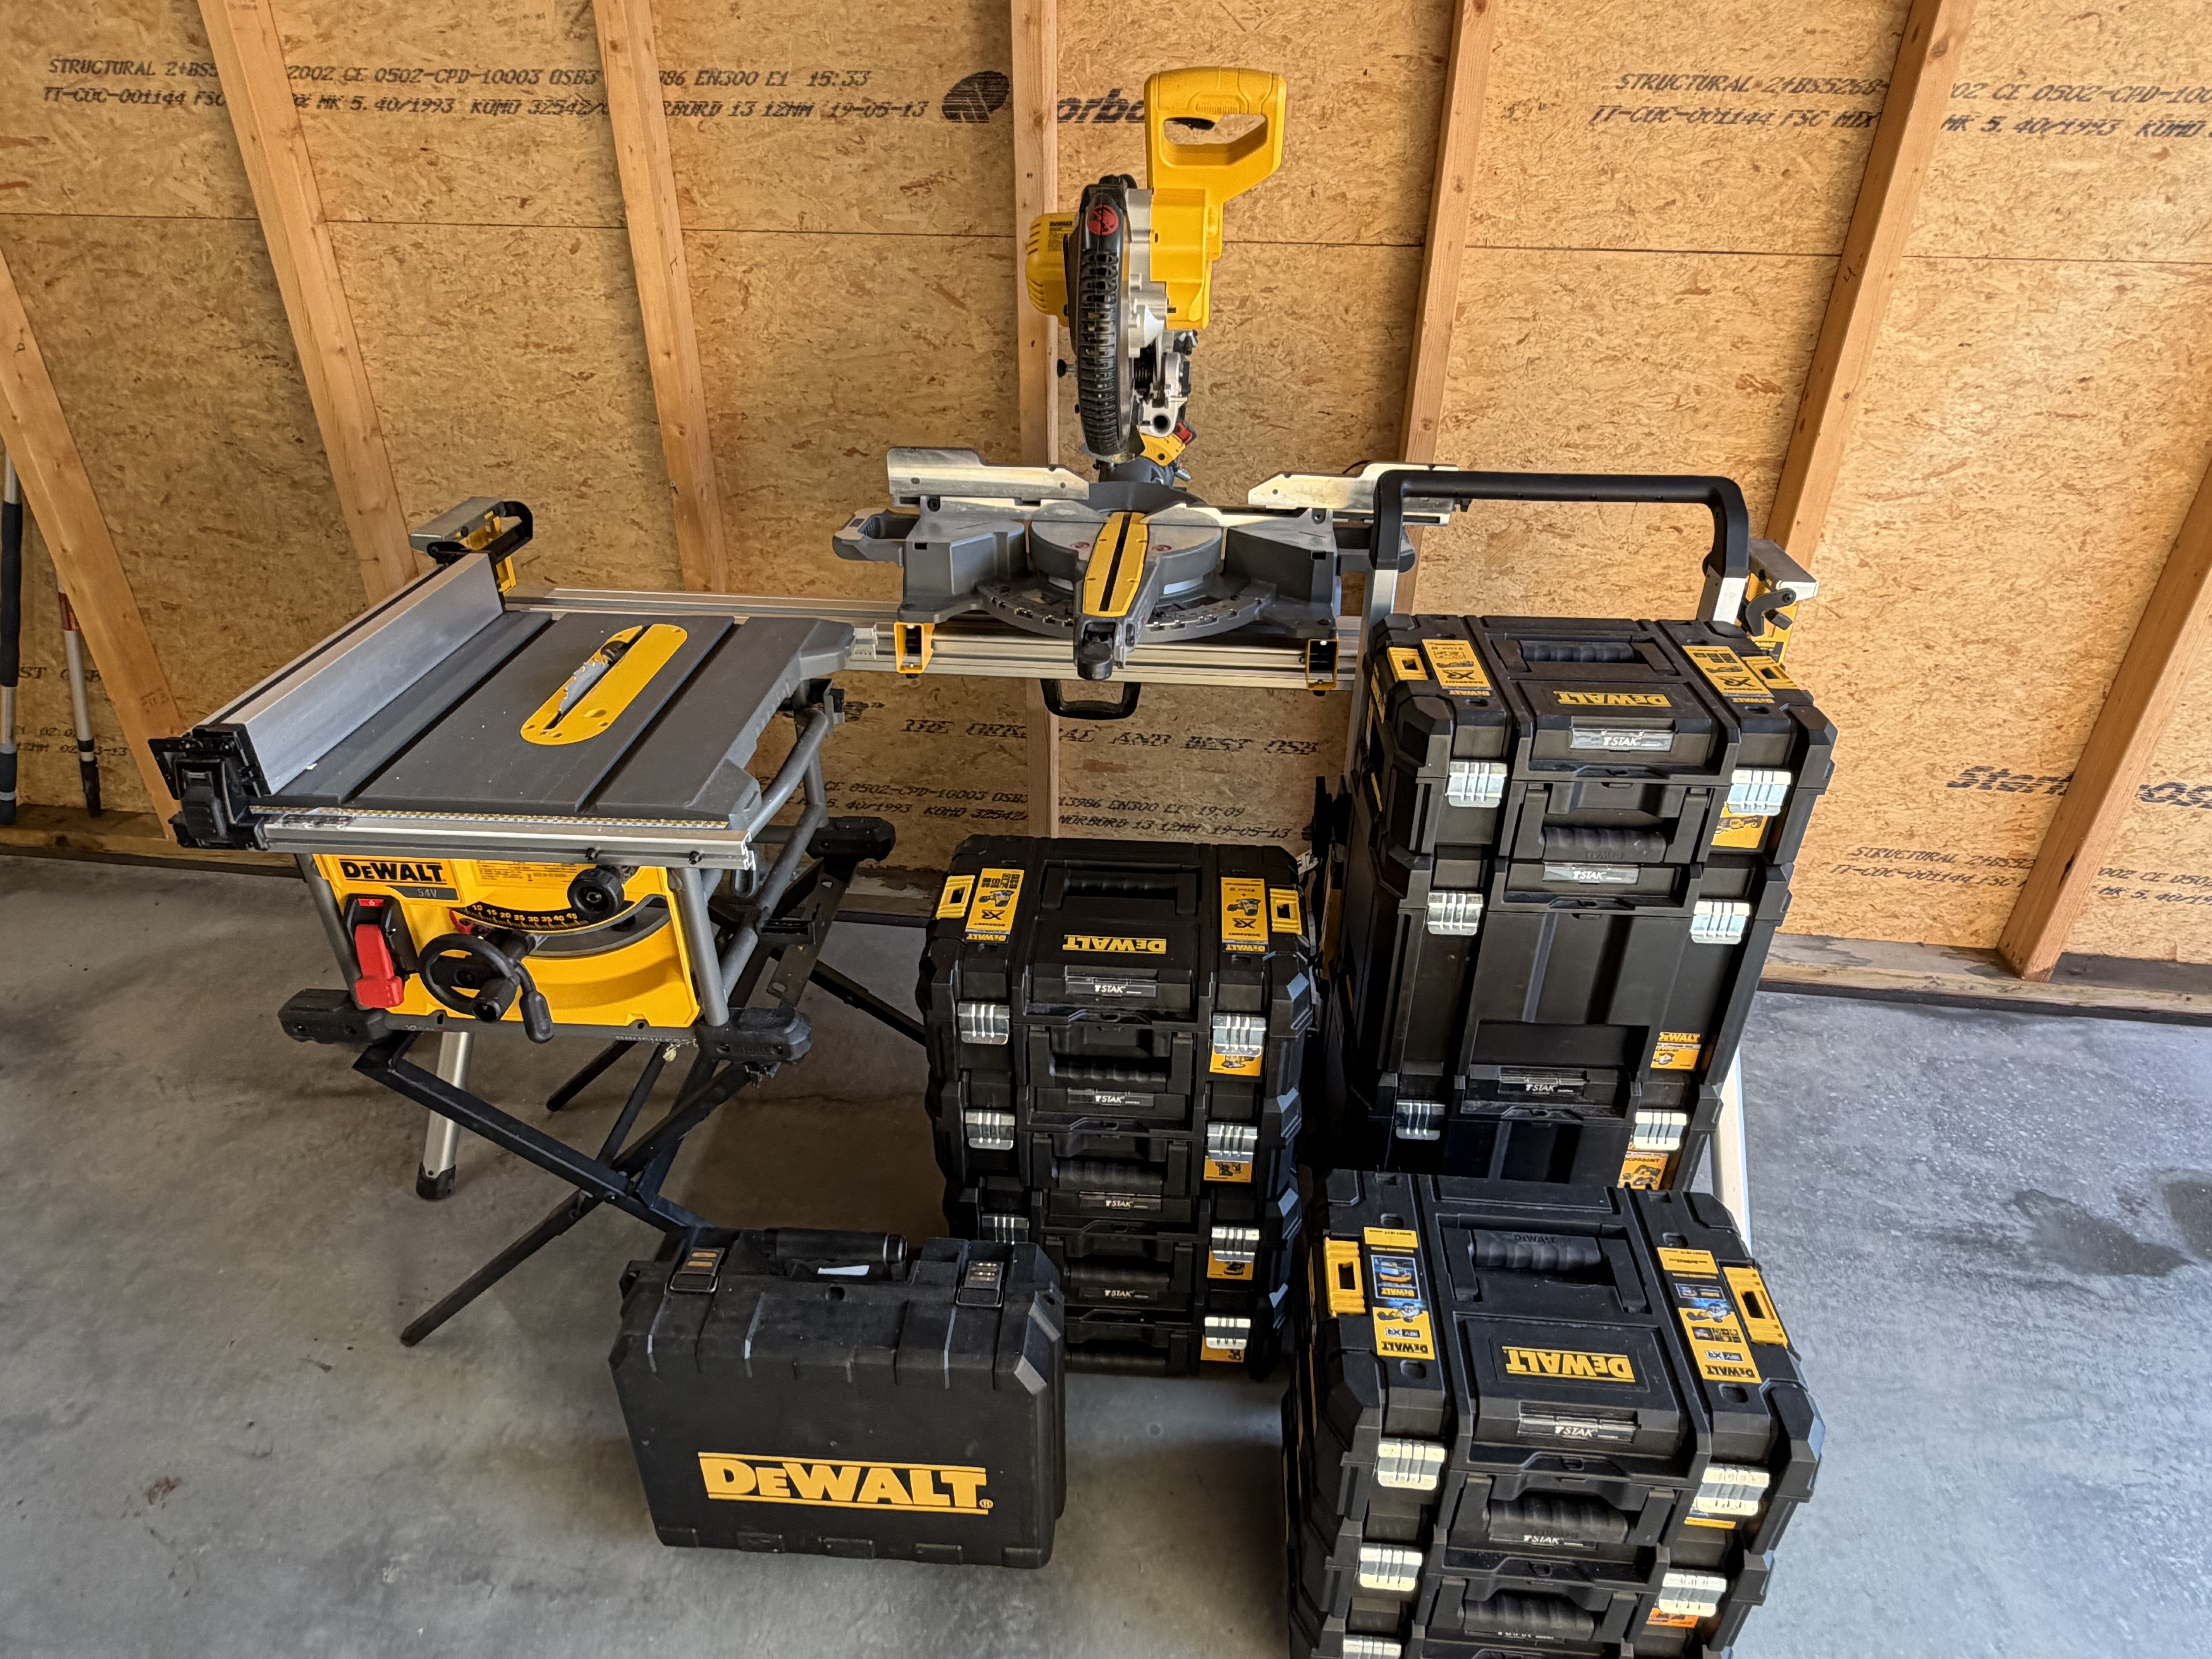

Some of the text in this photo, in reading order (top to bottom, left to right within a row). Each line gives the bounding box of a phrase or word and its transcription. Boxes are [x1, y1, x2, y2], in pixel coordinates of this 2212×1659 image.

[49, 58, 156, 76] STRUCTURAL
[343, 67, 369, 82] CE
[549, 69, 601, 85] OSB3
[694, 69, 760, 86] EN300
[1616, 73, 1754, 93] STRUCTURAL
[1992, 83, 2032, 100] CE
[1553, 691, 1671, 707] DEWALT
[1851, 847, 1958, 864] STRUCTURAL
[339, 860, 445, 882] DEWALT
[1063, 935, 1167, 954] DEWALT
[1381, 1340, 1429, 1354] DEWALT
[1504, 1350, 1635, 1380] DEWALT
[1704, 1364, 1756, 1378] DEWALT
[699, 1457, 988, 1509] DEWALT
